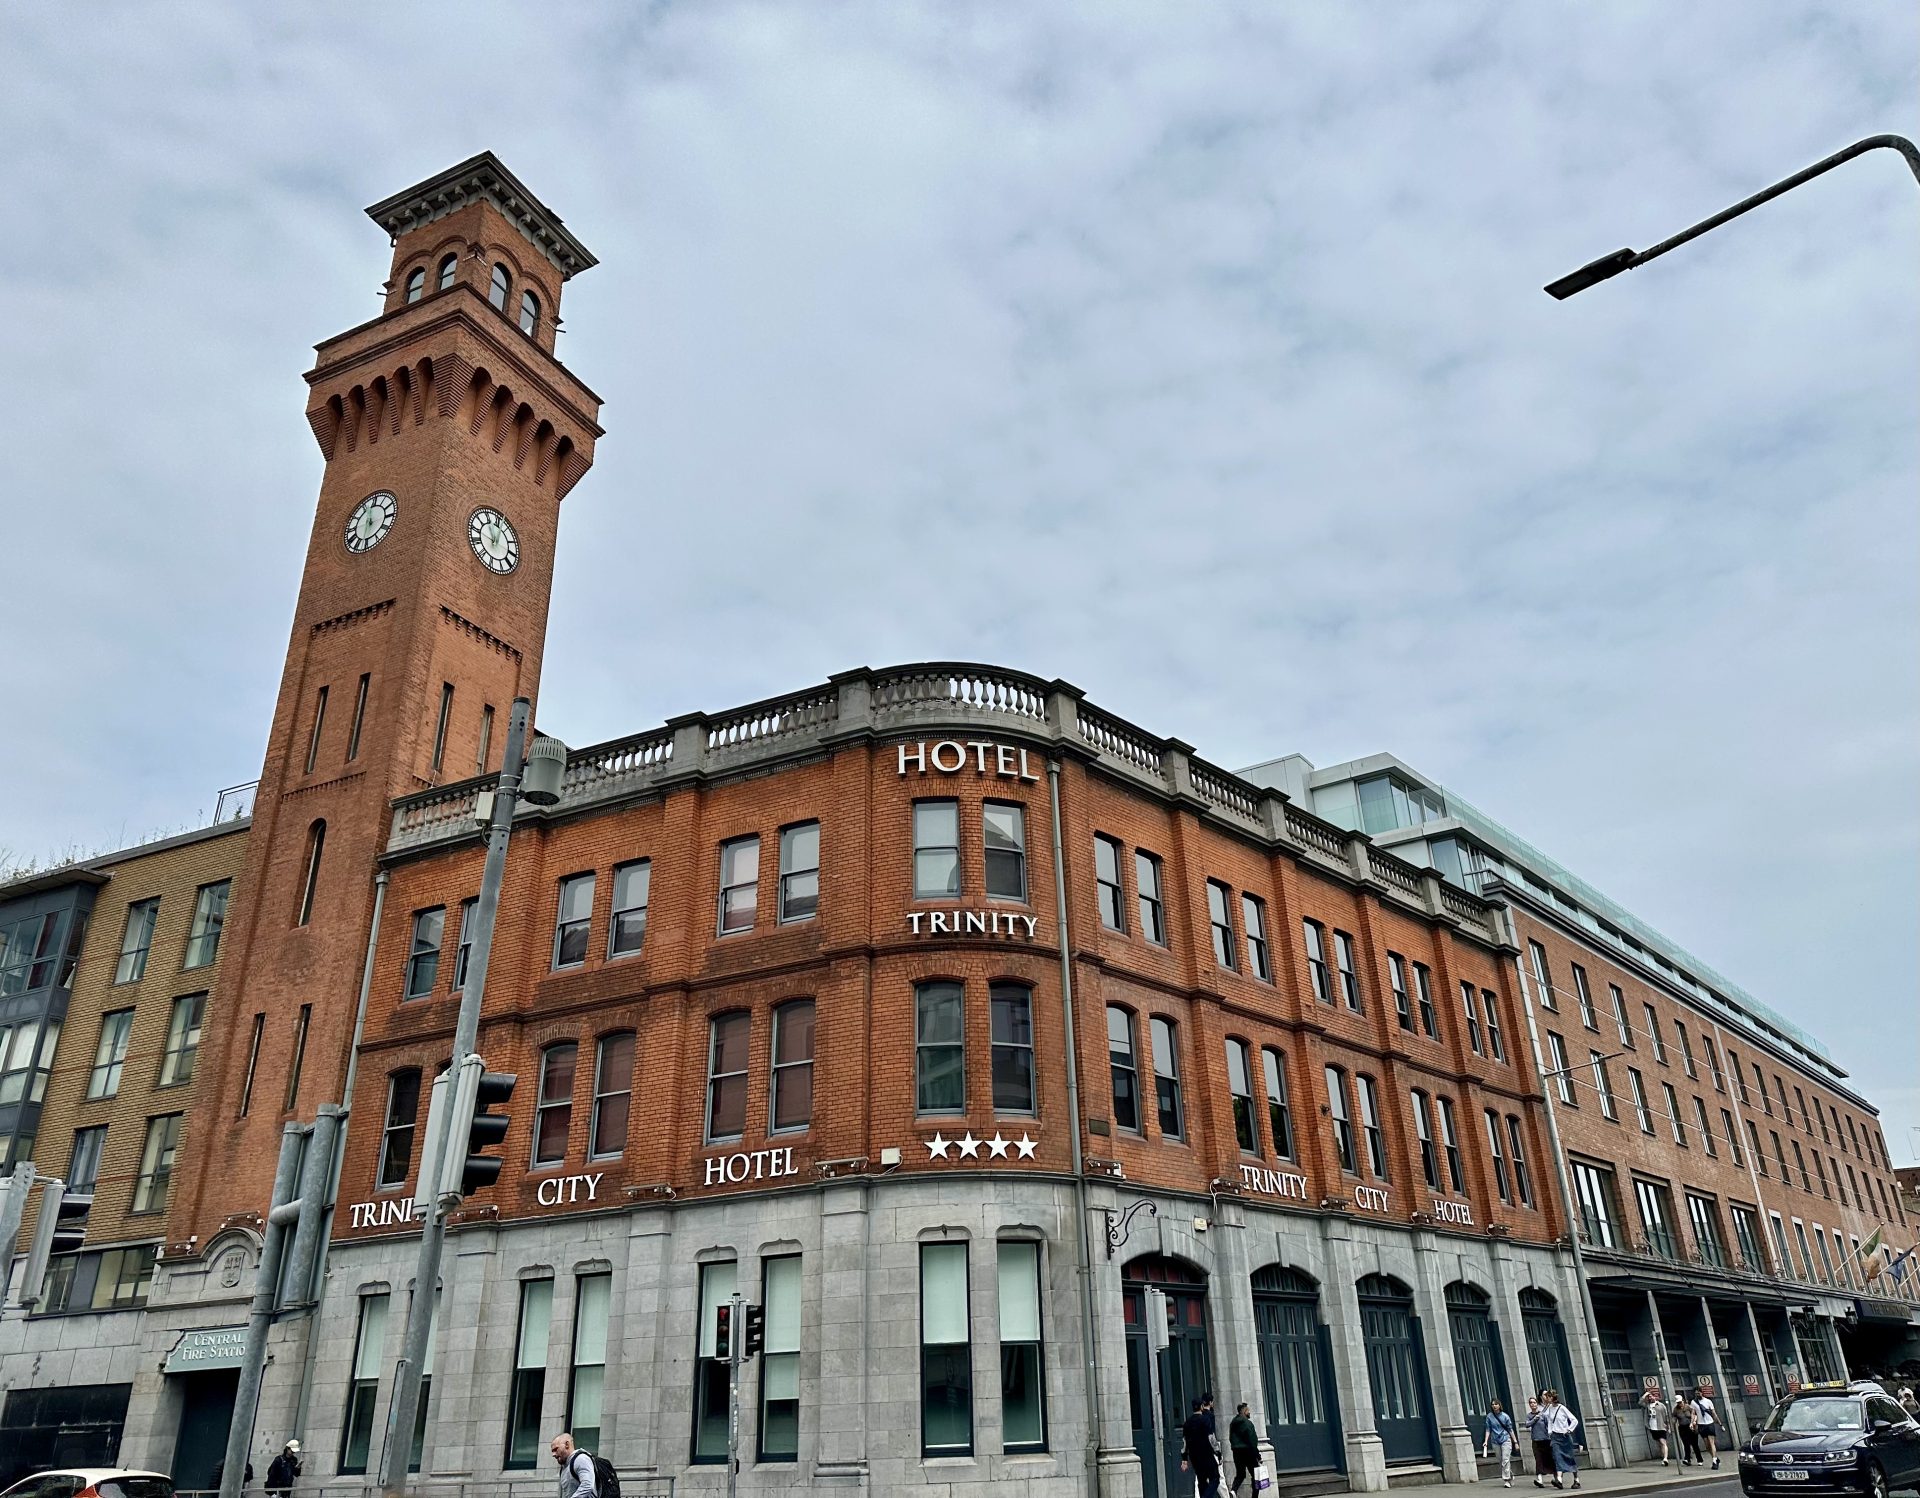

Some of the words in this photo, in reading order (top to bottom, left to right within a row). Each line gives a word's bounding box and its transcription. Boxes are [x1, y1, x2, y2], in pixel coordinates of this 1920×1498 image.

[898, 741, 1039, 782] HOTEL
[906, 911, 1038, 937] TRINITY
[349, 1198, 420, 1228] TRINI
[537, 1173, 604, 1206] CITY
[704, 1147, 799, 1186] HOTEL
[1240, 1164, 1307, 1200] TRINITY
[1355, 1186, 1388, 1212] CITY
[1434, 1200, 1475, 1226] HOTEL
[182, 1347, 207, 1360] FIRE
[209, 1345, 246, 1358] STATIO
[194, 1333, 244, 1346] CENTRAL
